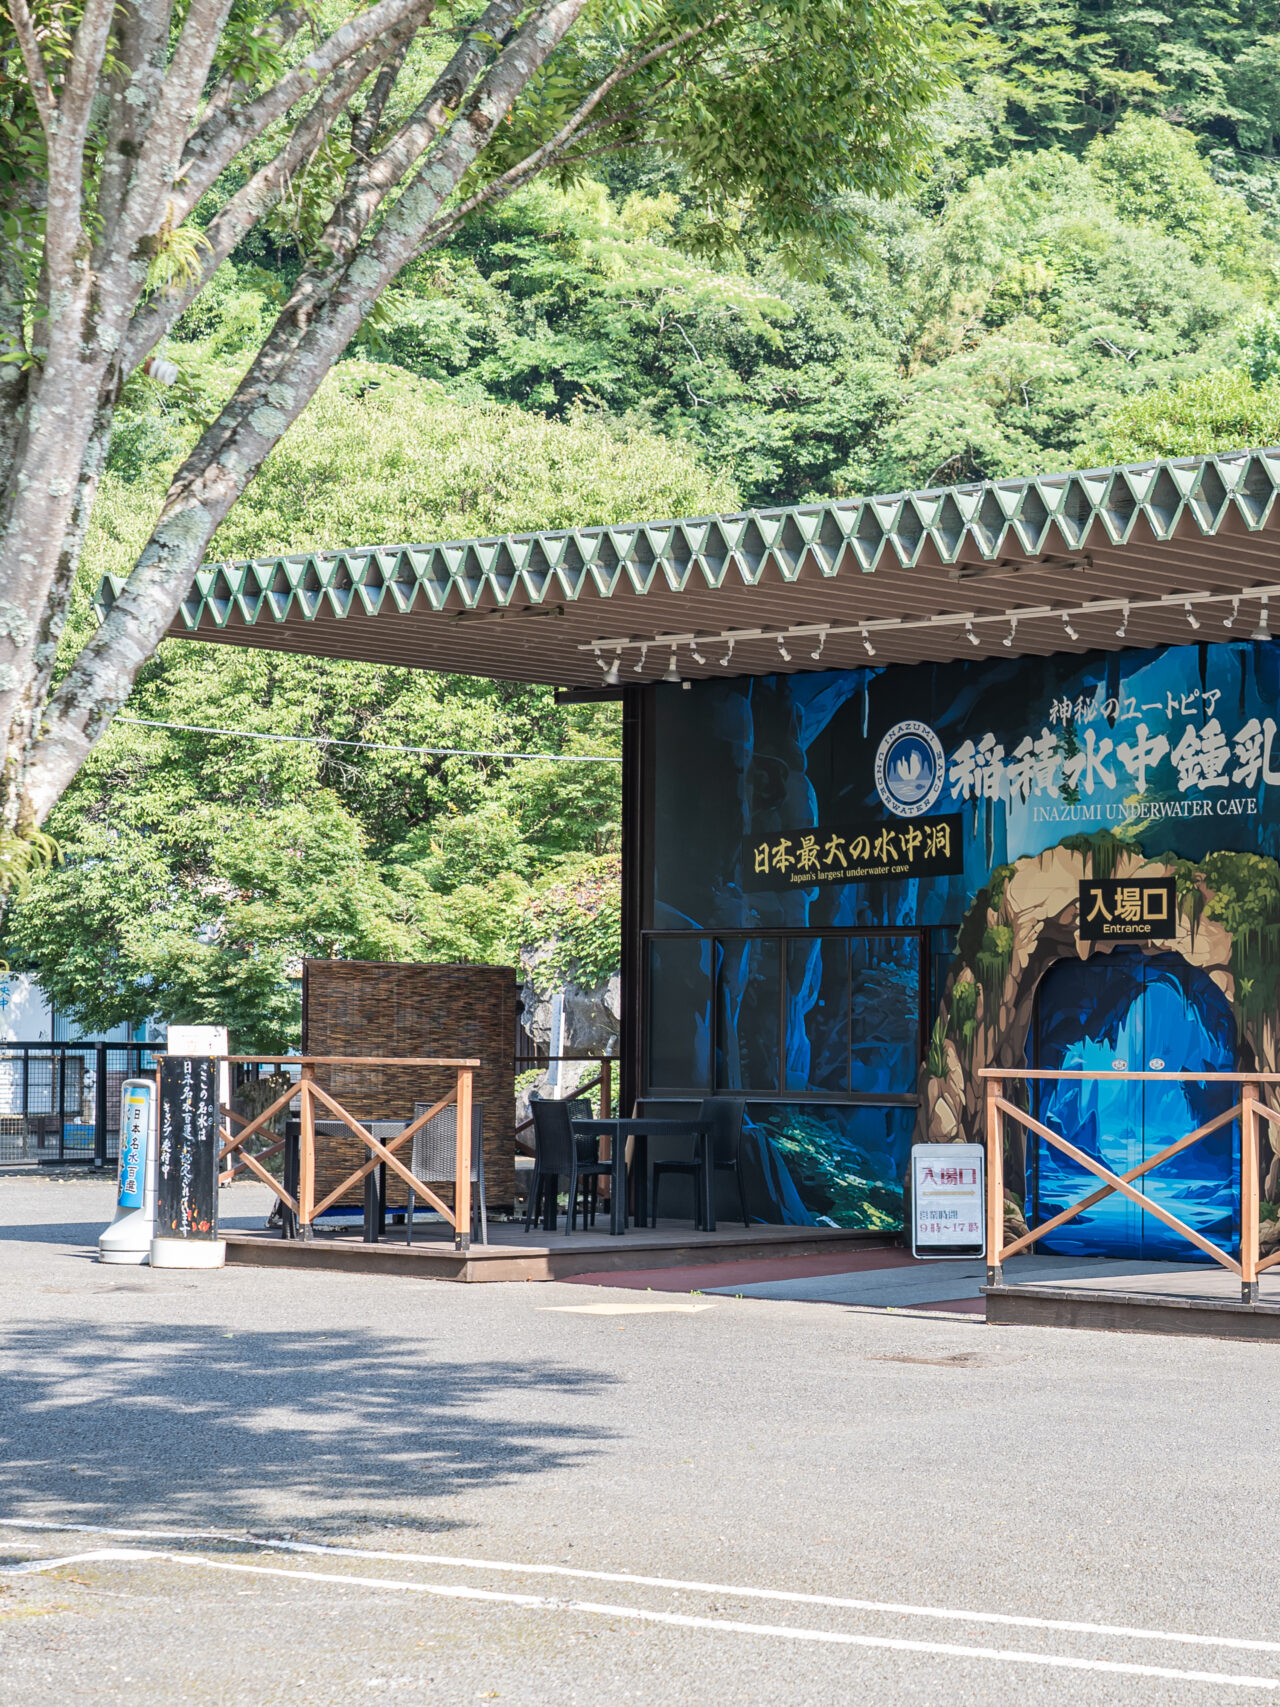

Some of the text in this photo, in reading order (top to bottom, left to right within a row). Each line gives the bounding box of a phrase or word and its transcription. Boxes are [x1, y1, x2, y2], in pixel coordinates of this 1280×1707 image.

[1048, 688, 1222, 726] 神秘のユートピア
[884, 723, 936, 745] INAZUMI
[876, 752, 931, 815] UNDERWATER
[933, 750, 943, 793] CAVE
[1032, 798, 1257, 822] INAZUMI UNDERWATER CAVE
[754, 822, 951, 874] 日本最大の水中洞
[790, 864, 909, 883] Japan's largest underwater cave
[1086, 887, 1168, 922] 入場口
[1103, 924, 1151, 934] Entrance
[125, 1109, 141, 1195] 日本名水百選
[920, 1167, 977, 1186] 入場口
